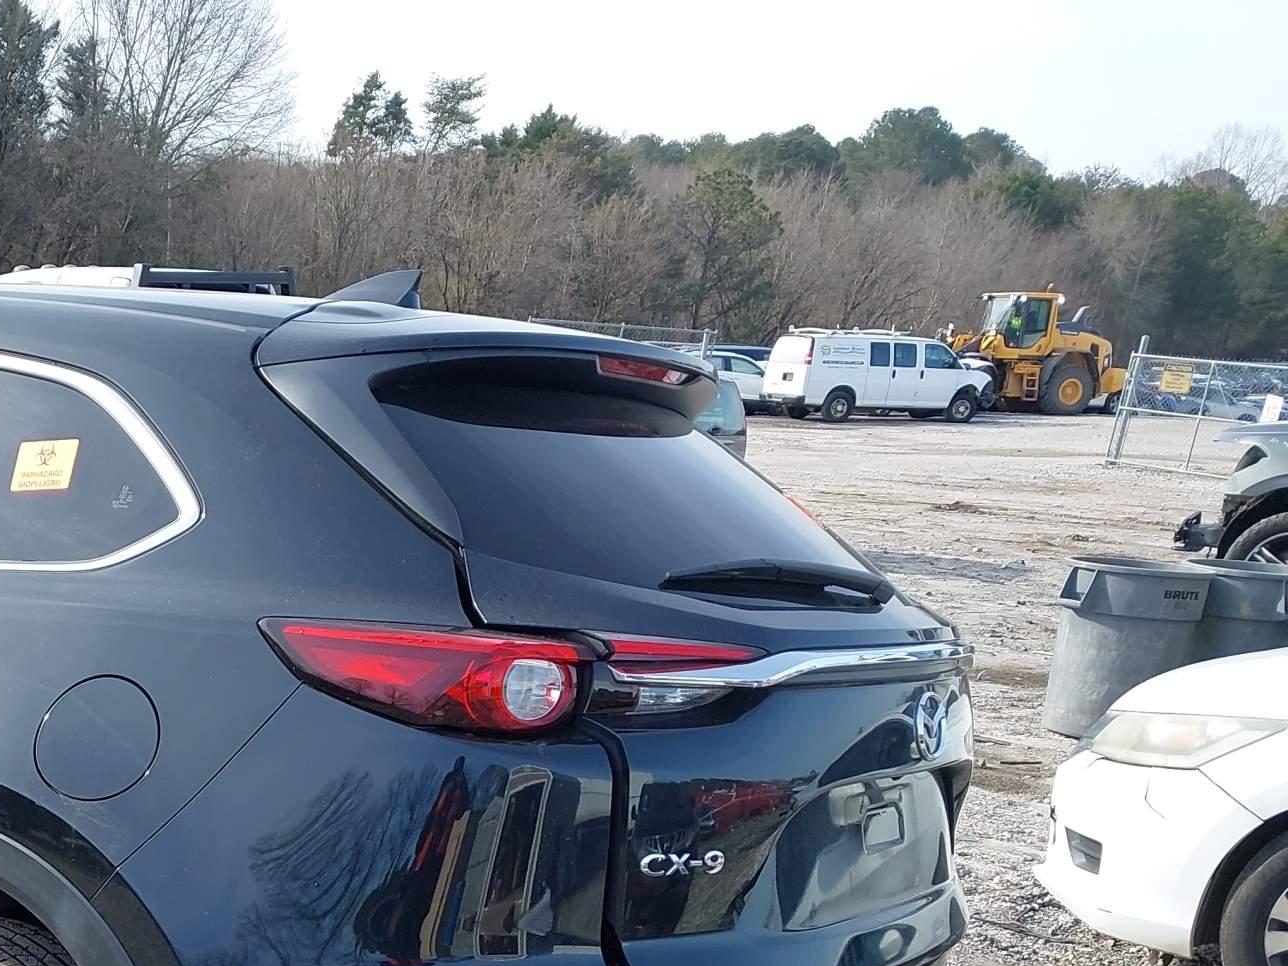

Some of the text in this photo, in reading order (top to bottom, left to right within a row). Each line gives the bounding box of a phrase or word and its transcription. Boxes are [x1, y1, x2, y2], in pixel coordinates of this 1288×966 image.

[21, 469, 63, 479] BIOHAZARD
[1164, 590, 1200, 601] BRUTE
[640, 850, 725, 877] CX-9
